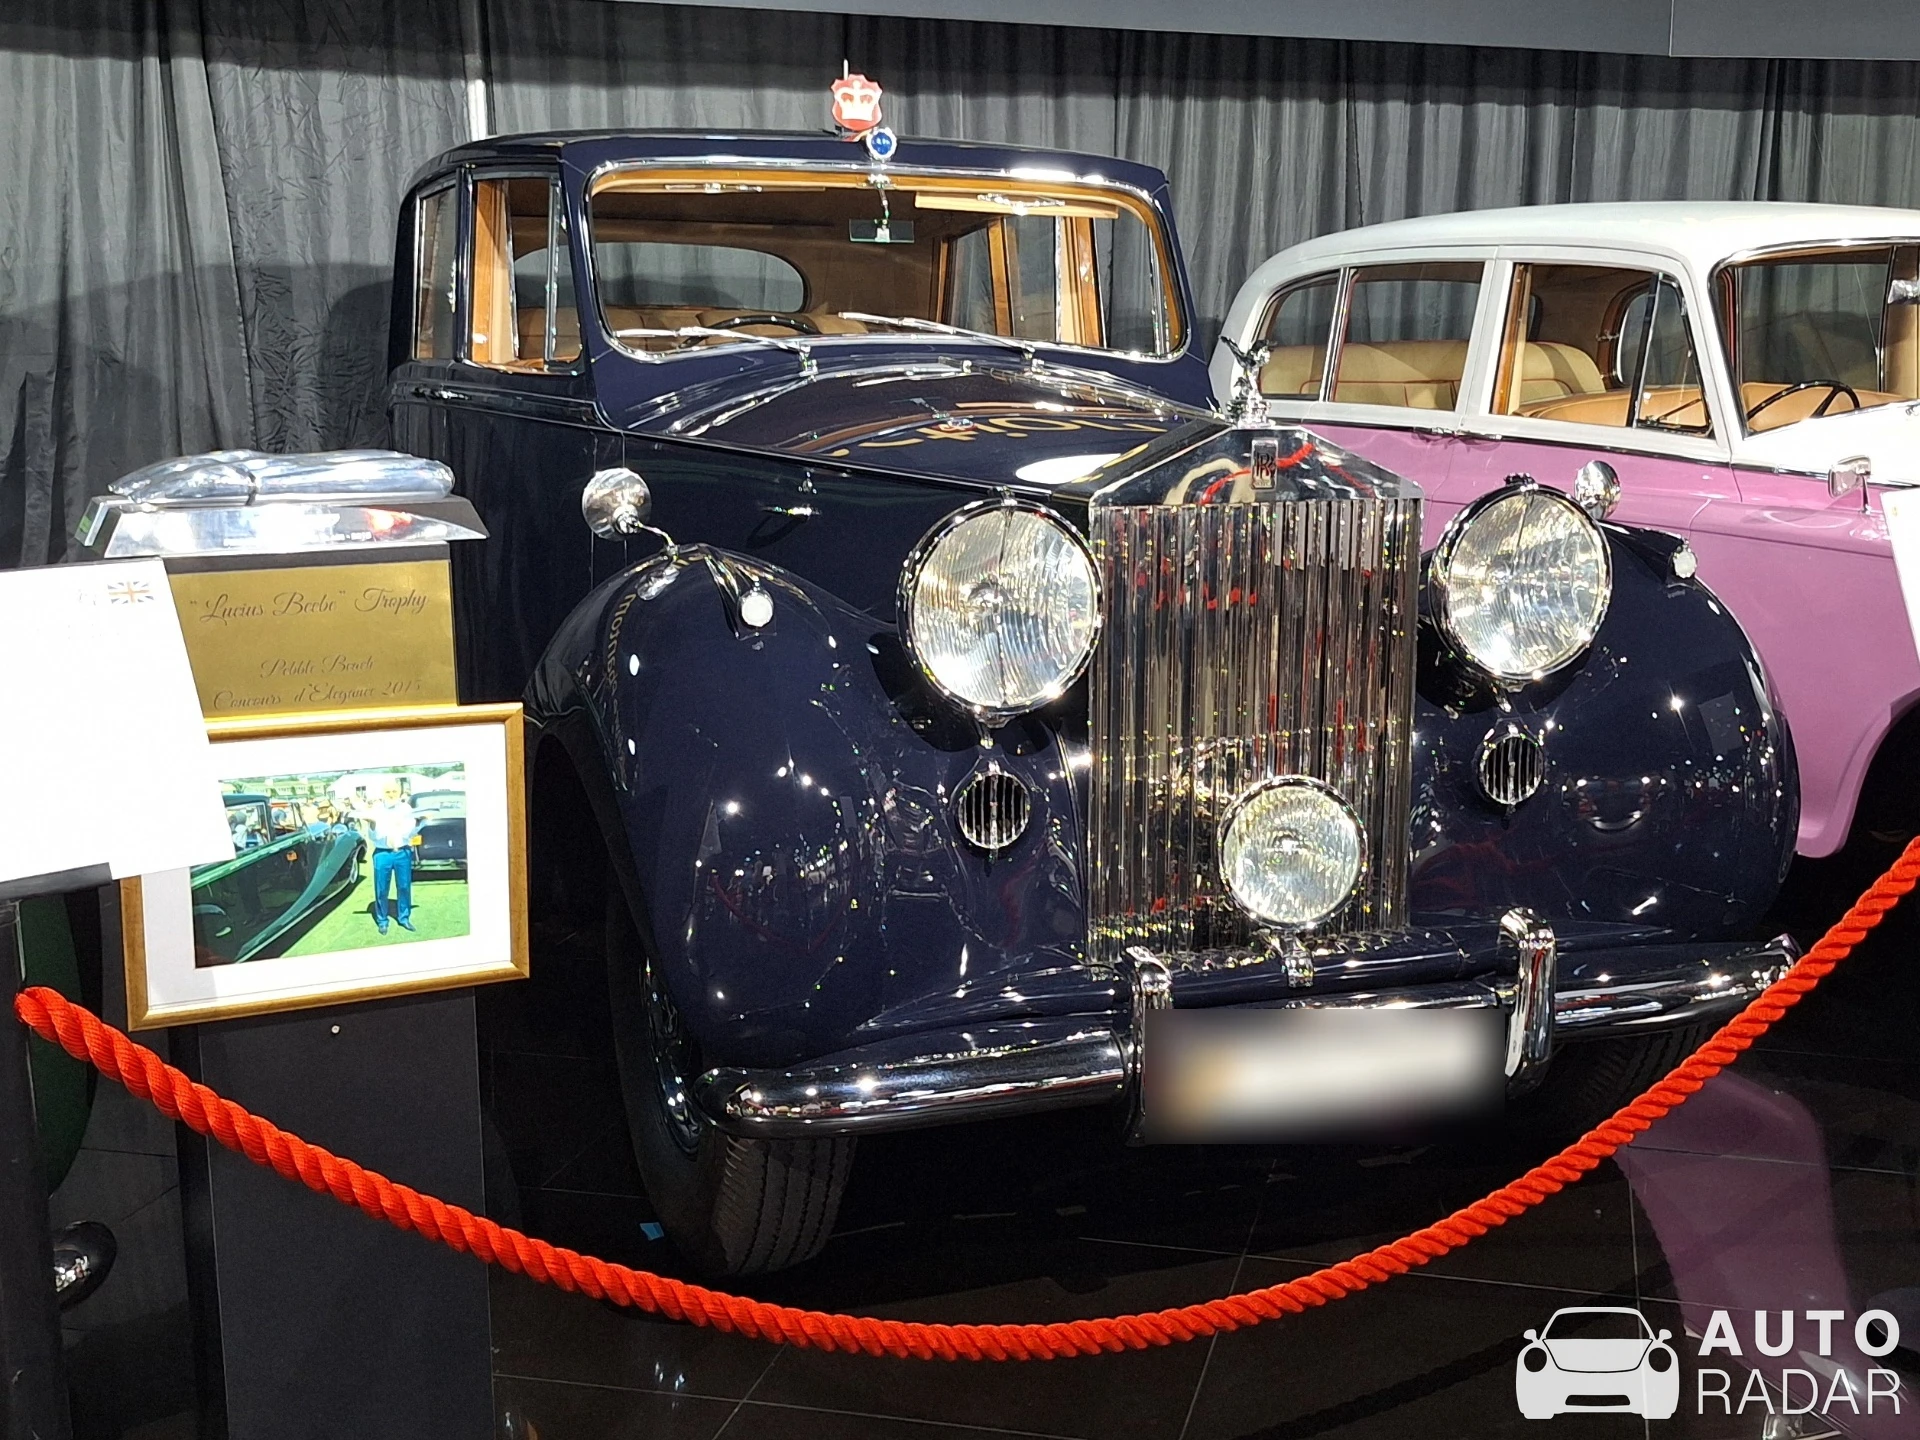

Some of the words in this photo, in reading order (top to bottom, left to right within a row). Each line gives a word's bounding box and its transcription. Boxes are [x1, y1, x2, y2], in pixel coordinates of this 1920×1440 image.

[354, 587, 427, 615] Trophy
[260, 658, 316, 678] Pebble
[321, 654, 374, 674] Beach
[213, 690, 282, 711] Concours
